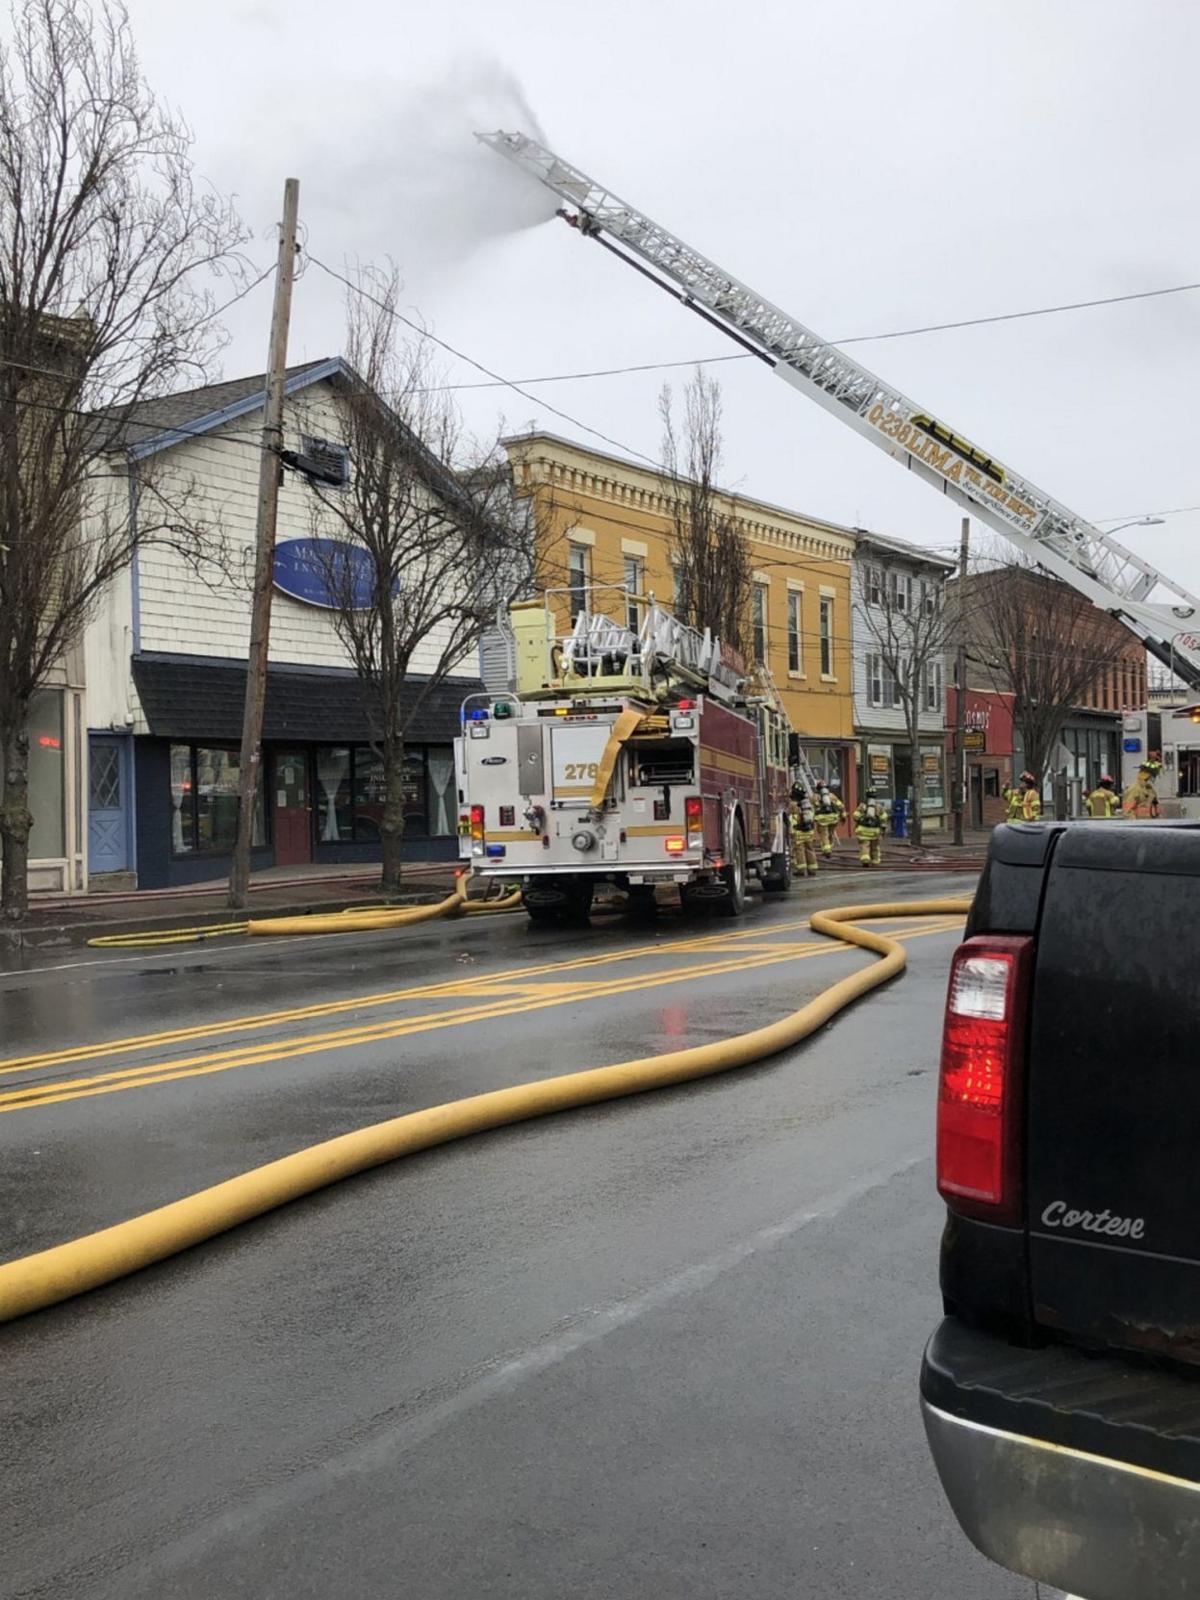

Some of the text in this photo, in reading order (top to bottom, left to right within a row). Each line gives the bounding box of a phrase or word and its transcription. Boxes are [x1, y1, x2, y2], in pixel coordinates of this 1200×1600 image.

[903, 429, 963, 484] LIMA
[982, 480, 1010, 505] FIRE
[565, 763, 600, 780] 278
[1041, 1200, 1145, 1239] Cortese
